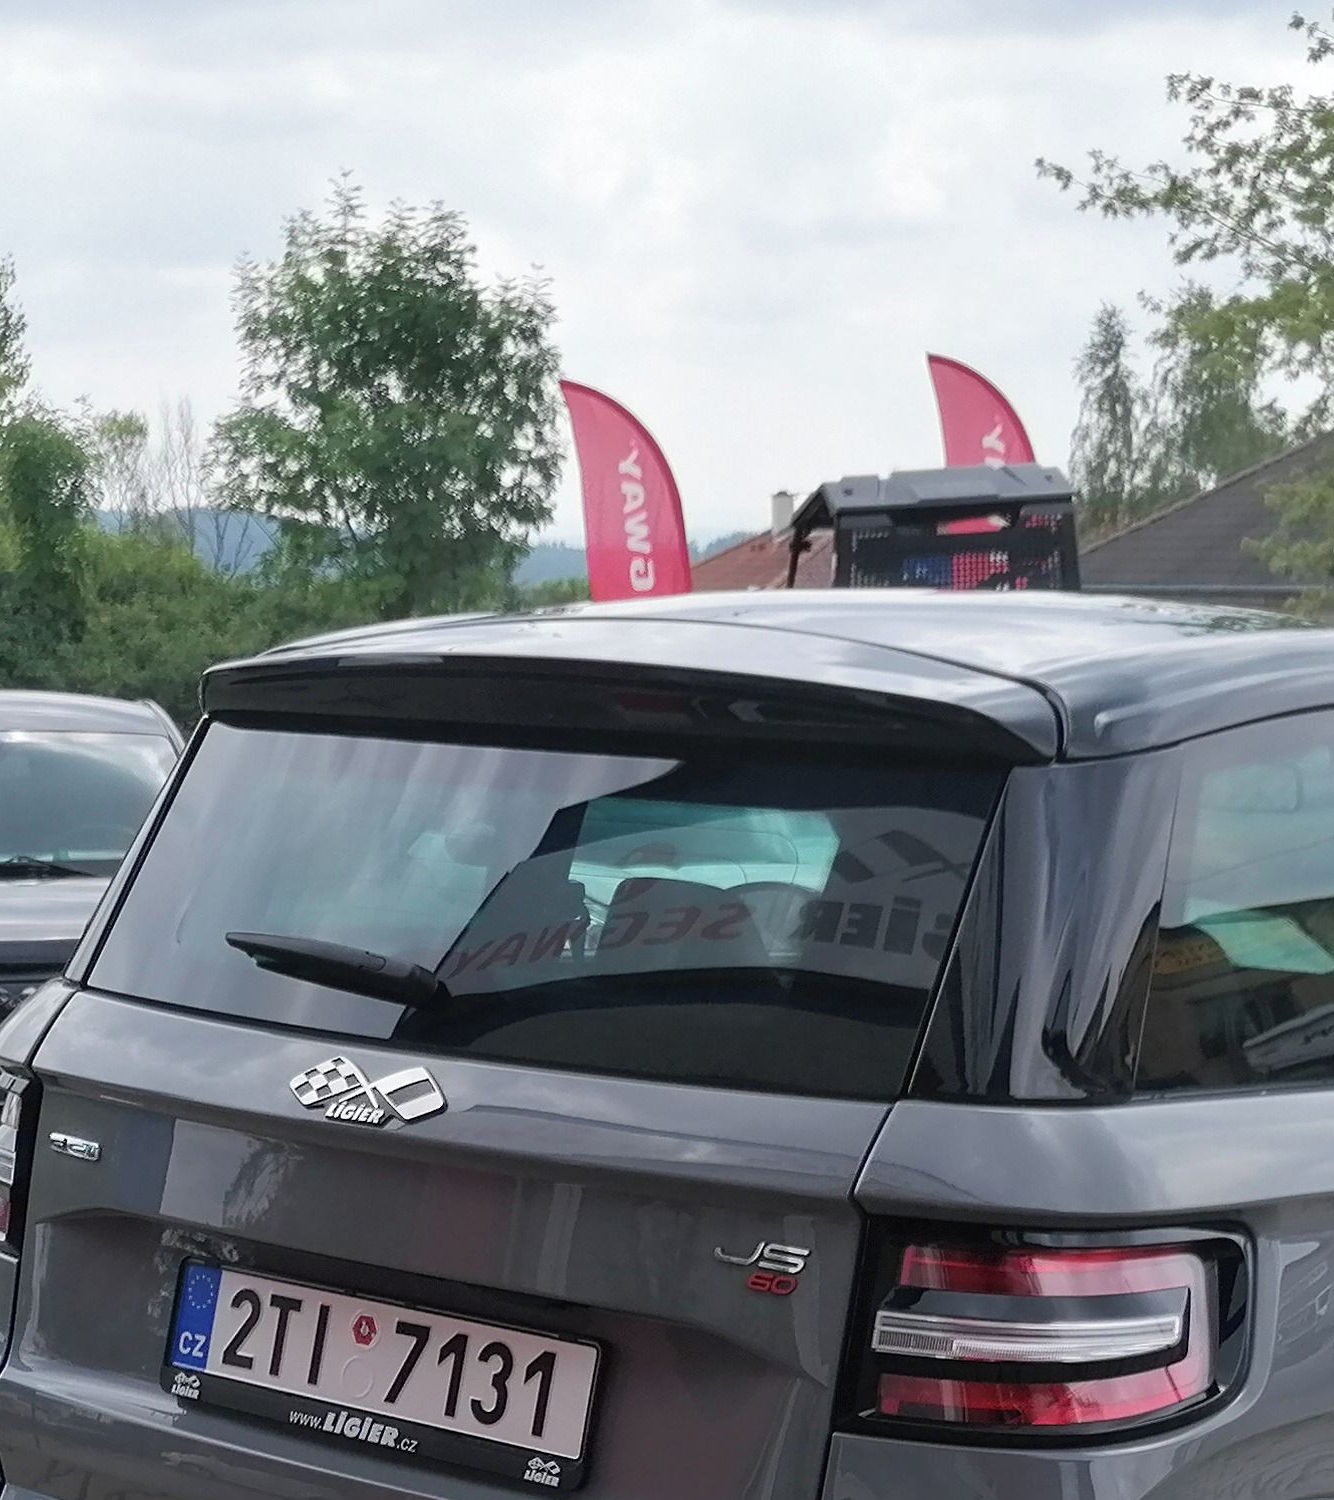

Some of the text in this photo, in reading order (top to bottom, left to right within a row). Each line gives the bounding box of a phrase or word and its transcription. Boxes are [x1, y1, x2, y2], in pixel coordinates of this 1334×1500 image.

[714, 1241, 810, 1274] JS
[747, 1271, 797, 1295] 60
[178, 1331, 205, 1358] CZ
[222, 1288, 560, 1438] 2TI 7131
